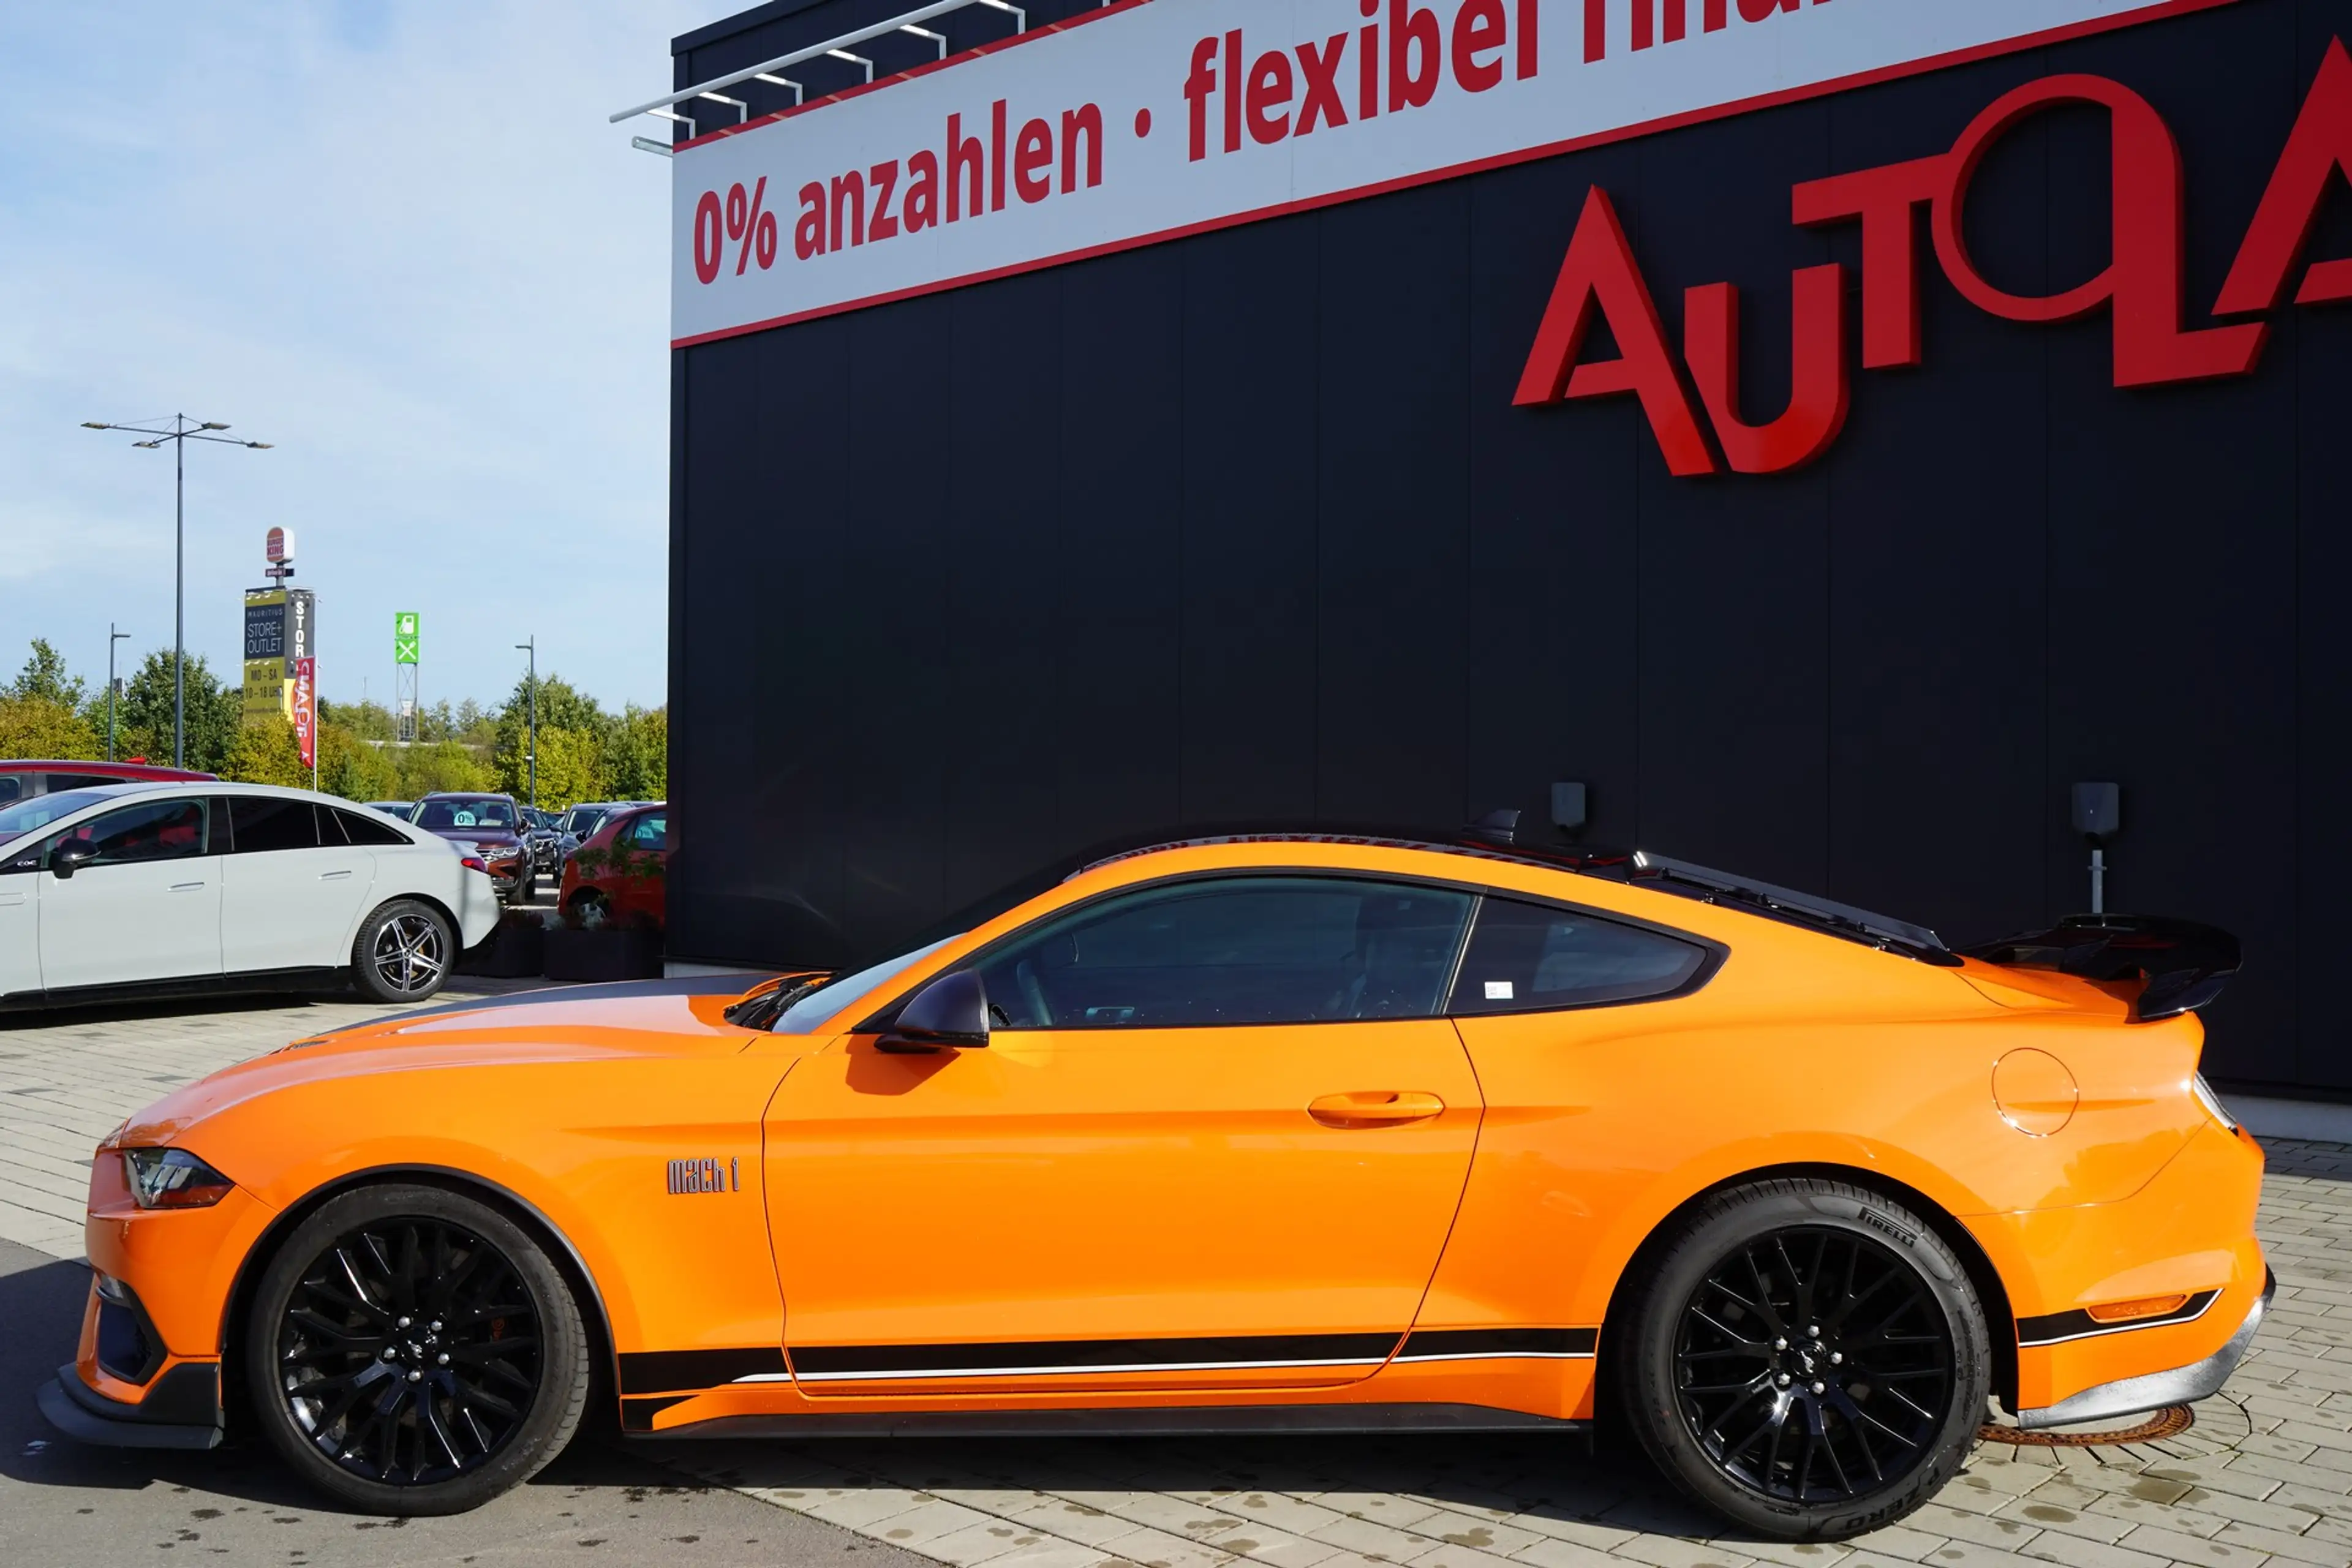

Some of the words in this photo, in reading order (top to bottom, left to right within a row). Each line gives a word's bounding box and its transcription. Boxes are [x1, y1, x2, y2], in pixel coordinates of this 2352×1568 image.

[694, 176, 777, 285] 0%
[794, 99, 1103, 260] anzahlen
[1184, 0, 1539, 162] flexibel
[247, 637, 282, 654] OUTLET
[295, 601, 304, 657] STOR
[269, 668, 277, 680] SA
[731, 1156, 739, 1191] 1
[1858, 1205, 1918, 1248] PIRELLI
